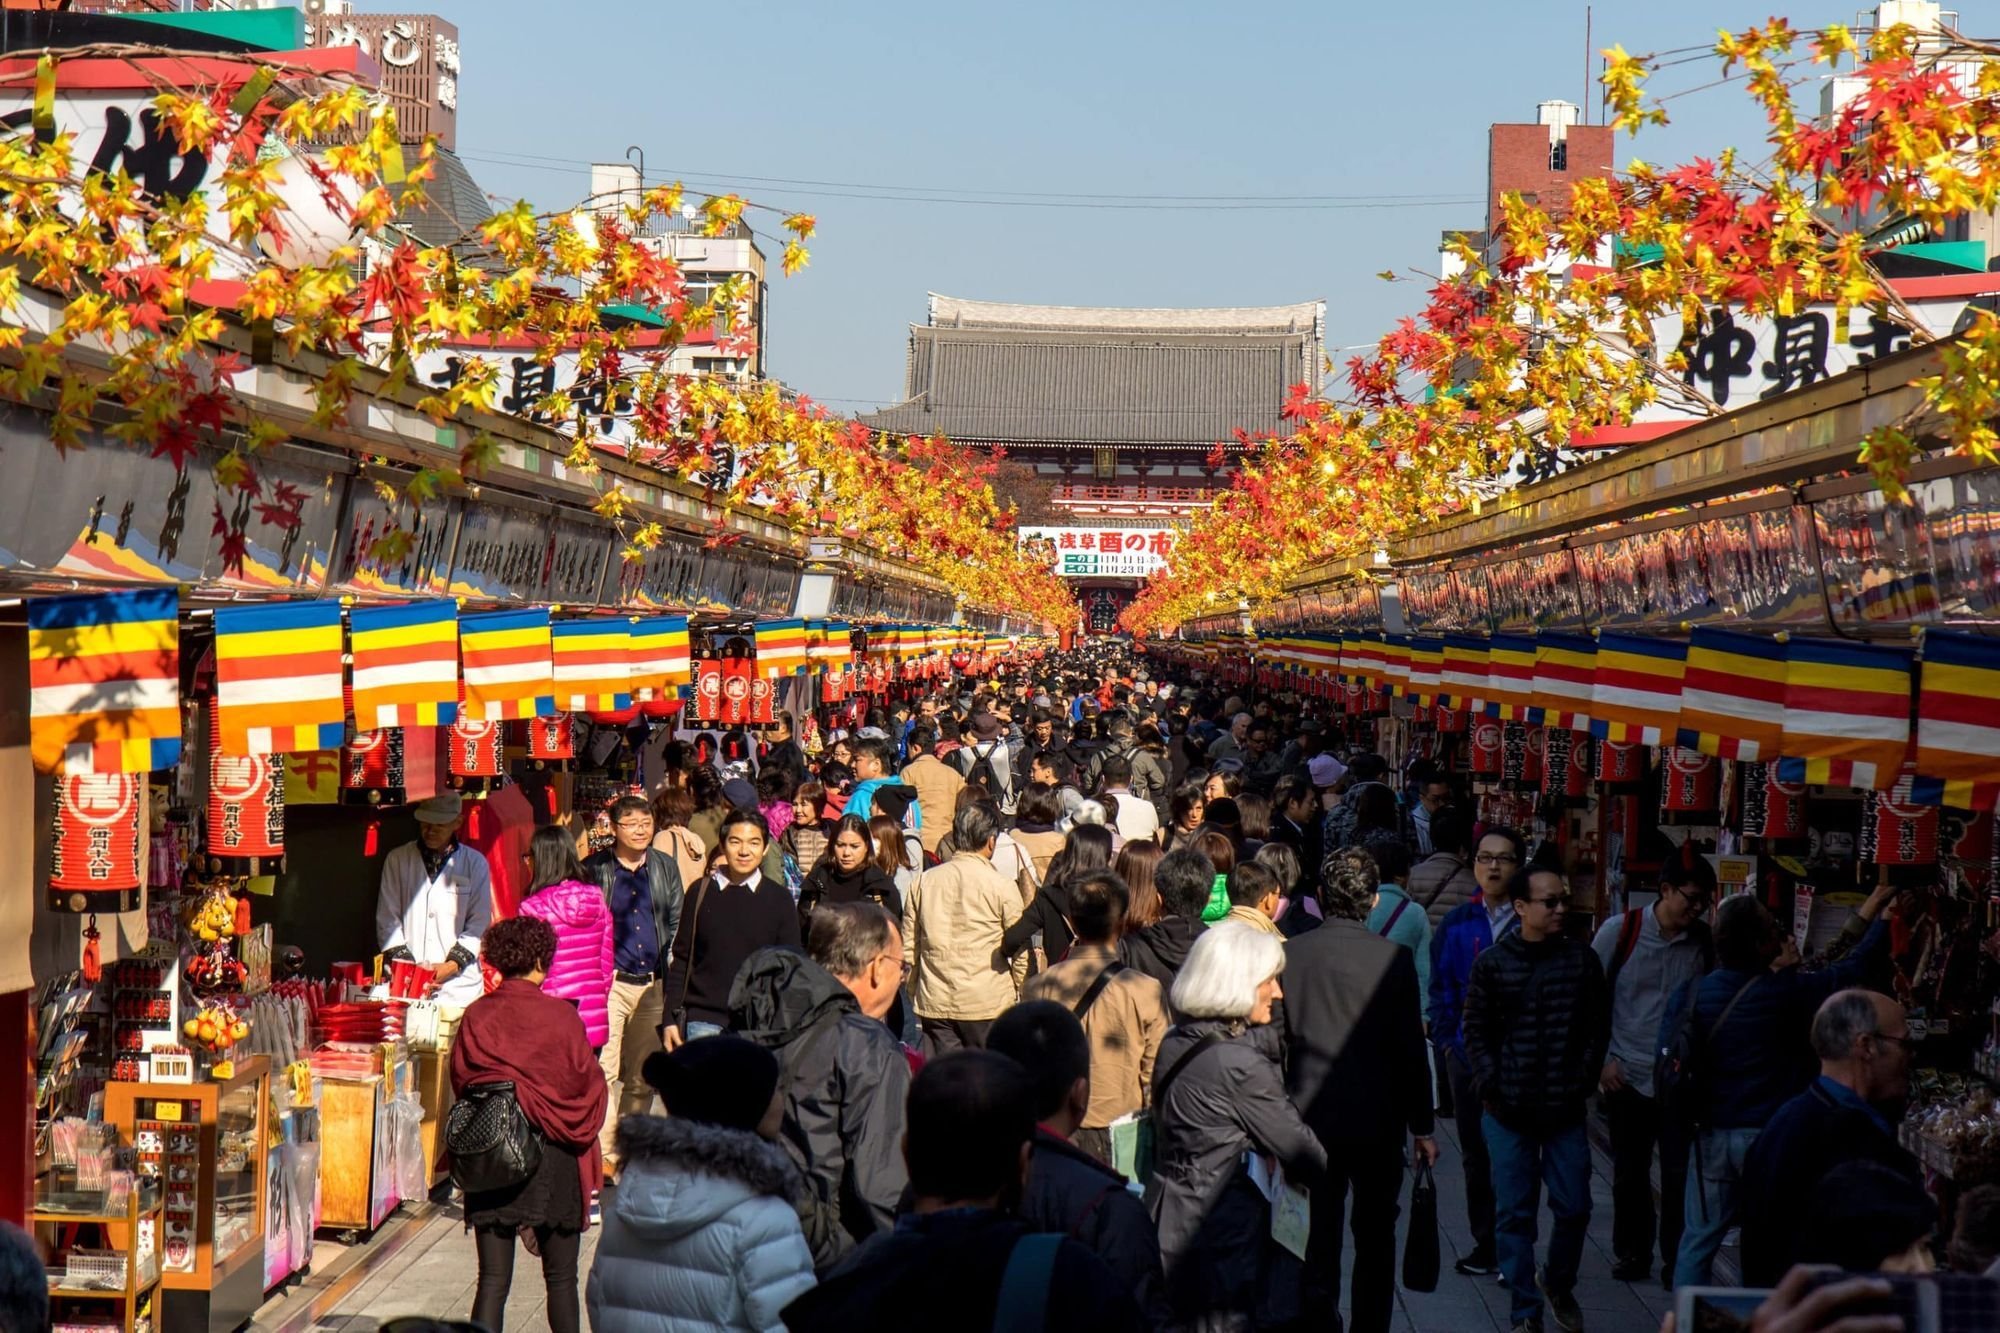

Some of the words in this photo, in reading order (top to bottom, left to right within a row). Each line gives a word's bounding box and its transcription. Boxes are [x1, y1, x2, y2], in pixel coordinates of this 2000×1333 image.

[1059, 531, 1172, 554] 浅草酉の市
